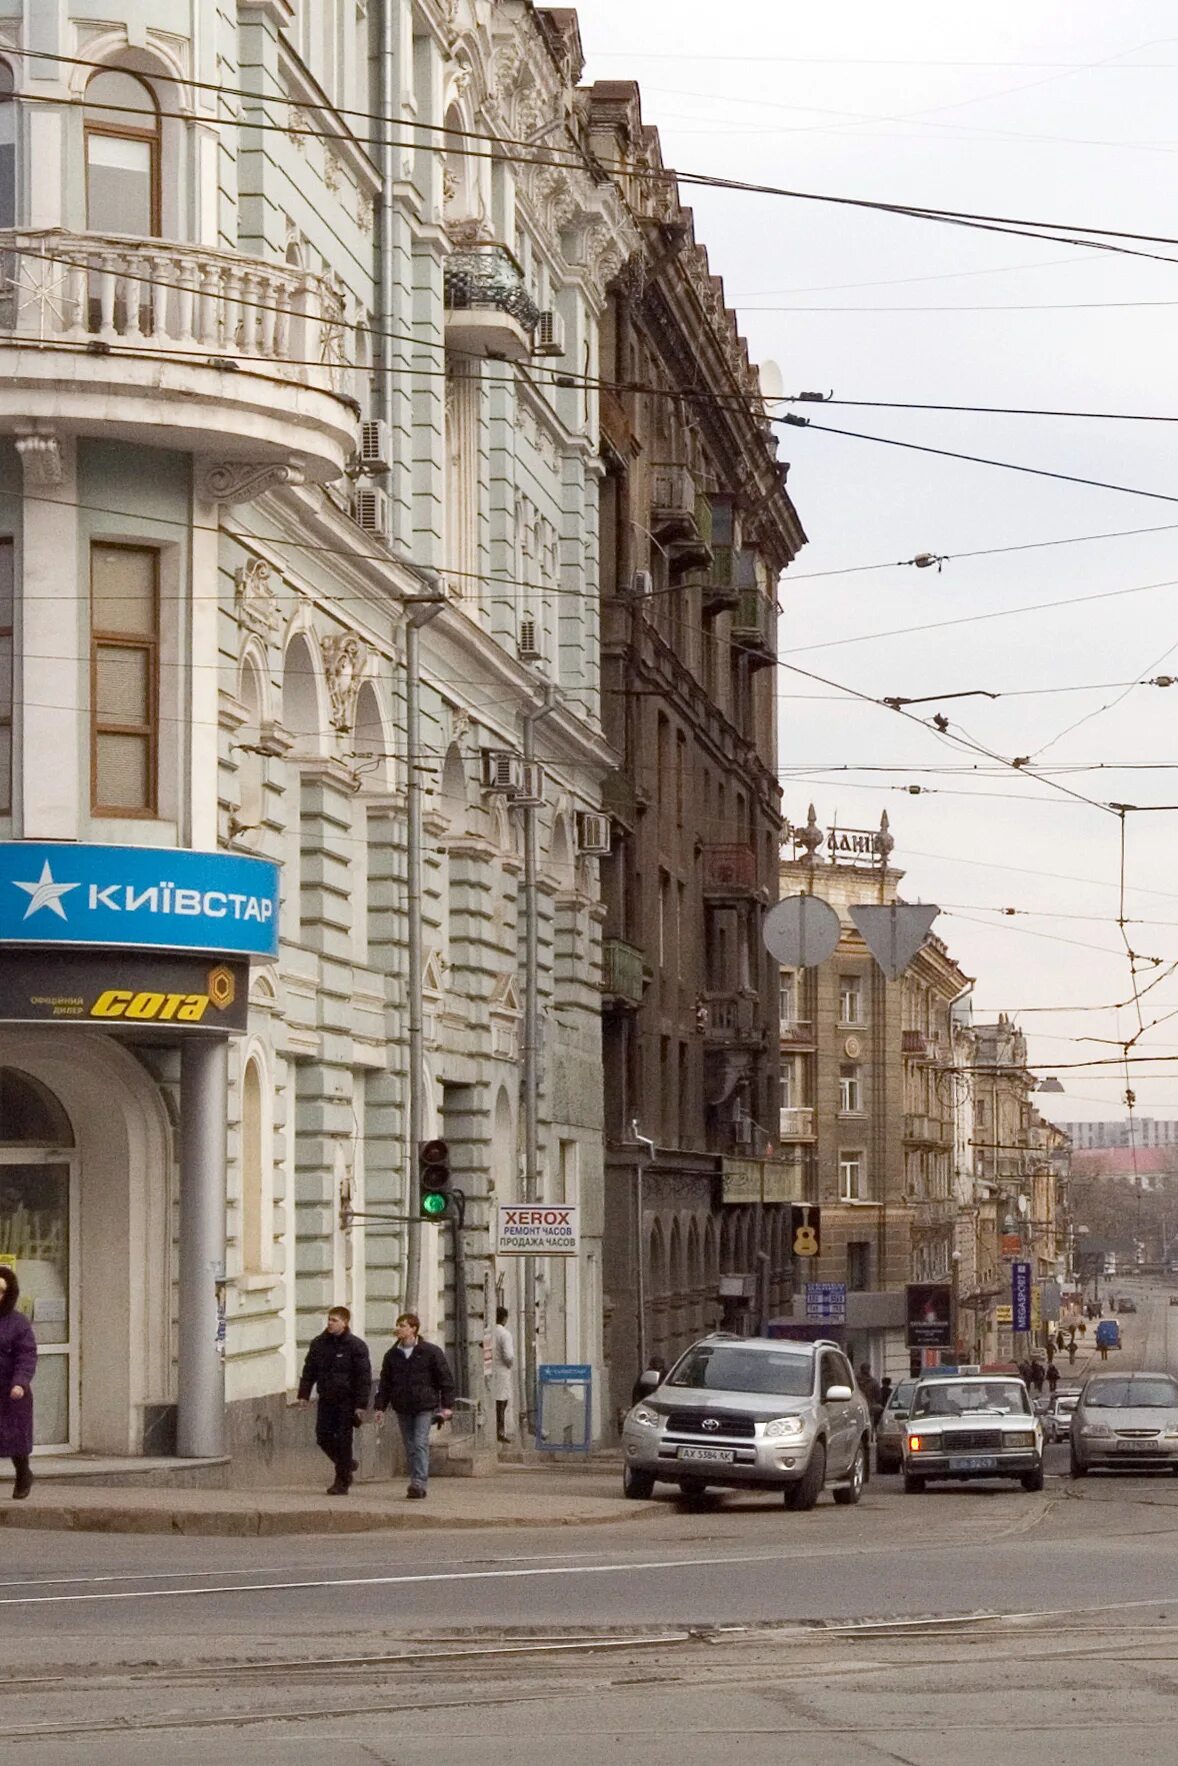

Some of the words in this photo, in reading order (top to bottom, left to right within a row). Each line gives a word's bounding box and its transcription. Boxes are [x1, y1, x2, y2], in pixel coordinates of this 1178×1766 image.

[88, 881, 273, 924] КИЇВСТАР
[505, 1212, 570, 1225] XEROX
[504, 1227, 540, 1236] РЕМОНТ
[543, 1227, 572, 1236] ЧАСОВ
[500, 1238, 544, 1248] ПРОДАЖА
[546, 1238, 576, 1247] ЧАСОВ
[1017, 1275, 1026, 1328] MEGASPORT
